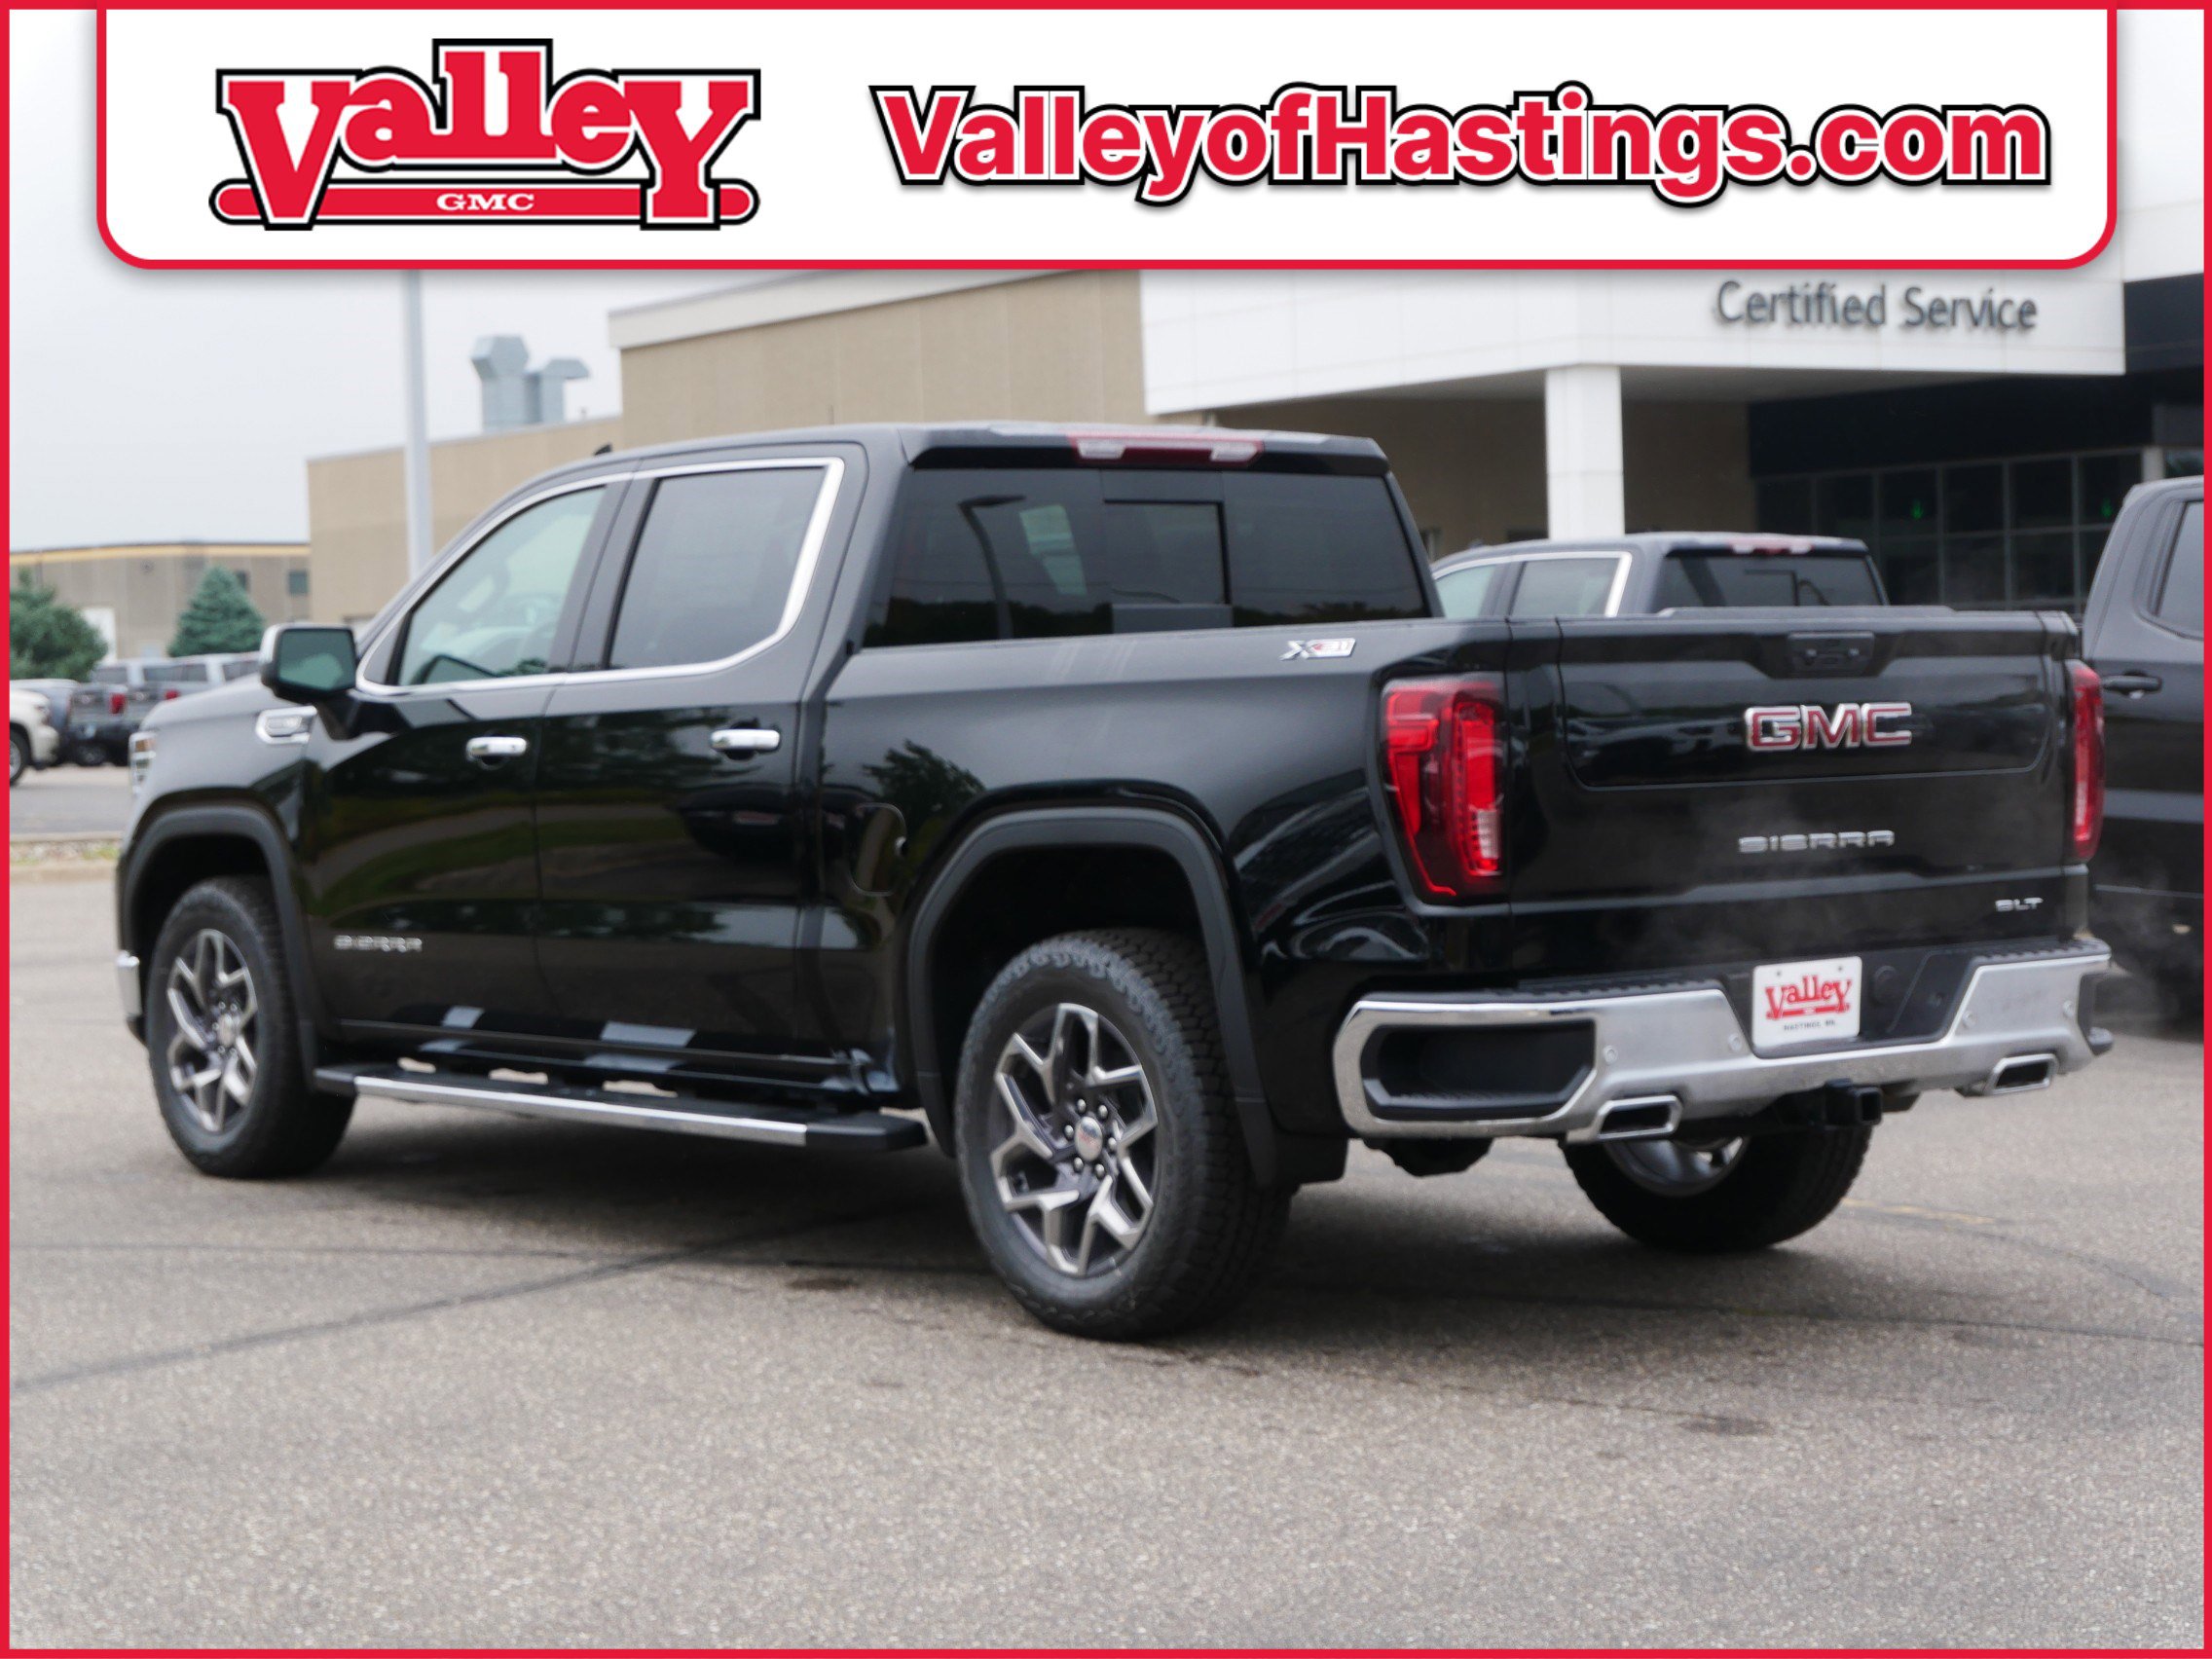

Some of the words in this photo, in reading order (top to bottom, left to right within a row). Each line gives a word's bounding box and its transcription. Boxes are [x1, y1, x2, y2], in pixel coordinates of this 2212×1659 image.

[1716, 280, 1887, 326] Certified
[1904, 286, 2038, 329] Service
[1744, 702, 1912, 752] GMC
[1738, 830, 1895, 853] SIERRA
[1995, 897, 2044, 912] SLT
[333, 935, 423, 952] SIERRA
